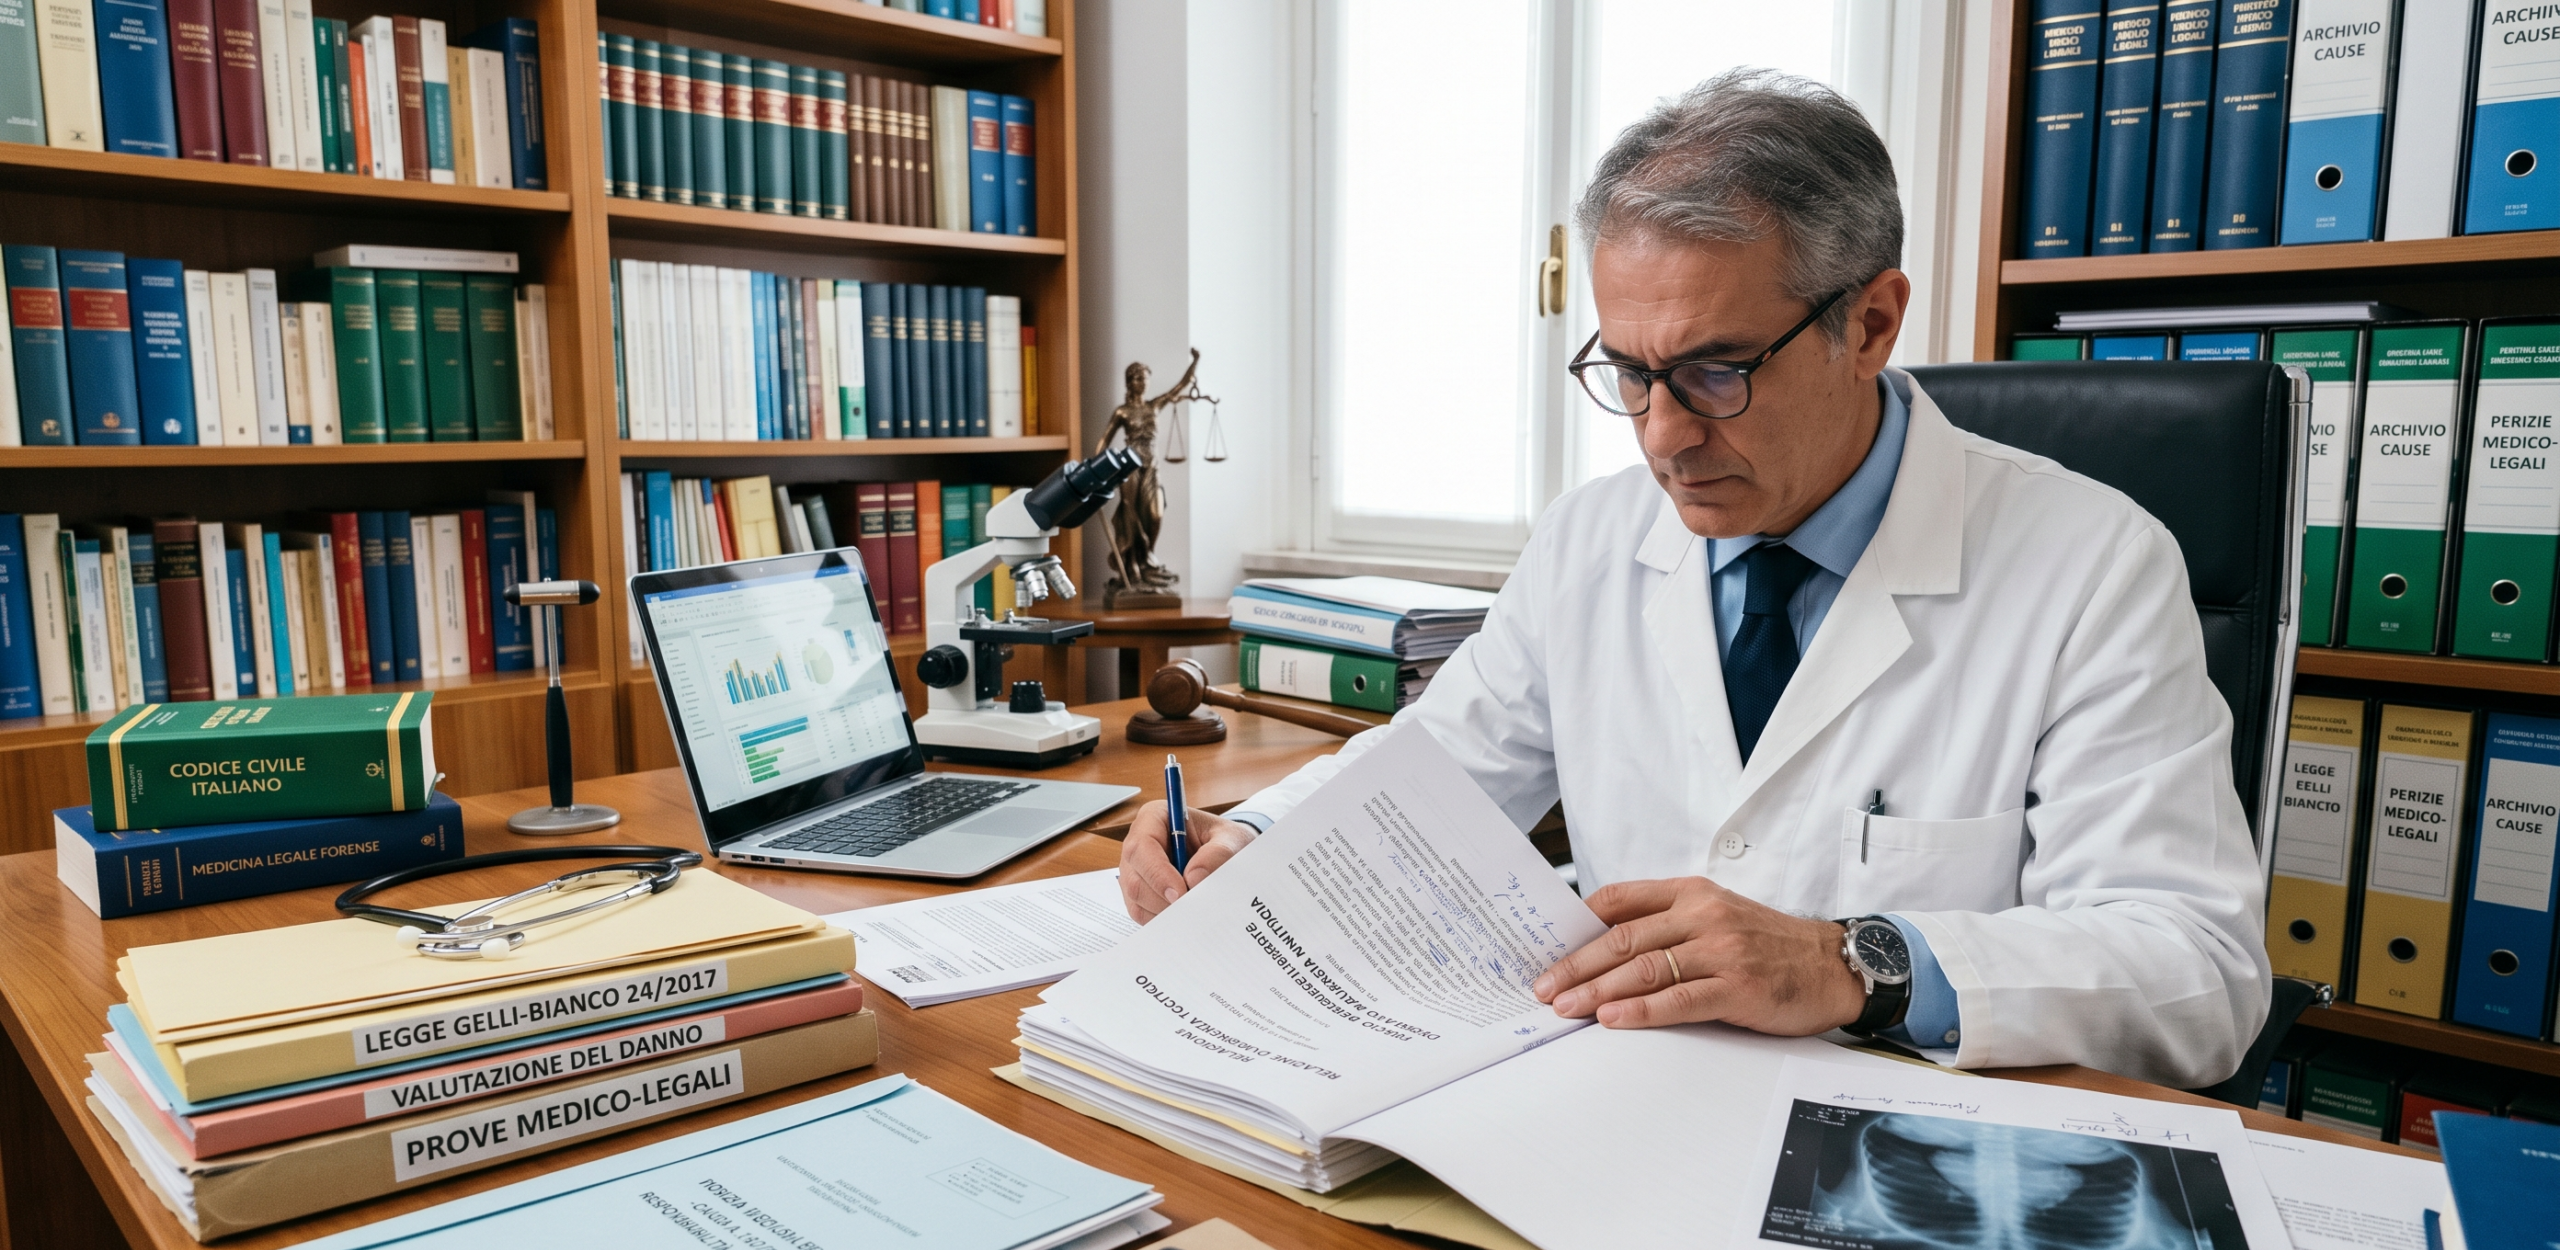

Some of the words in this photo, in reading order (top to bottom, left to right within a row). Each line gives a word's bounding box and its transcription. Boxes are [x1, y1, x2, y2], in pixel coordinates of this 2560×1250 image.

[2303, 21, 2381, 42] ARCHIVIO
[2314, 43, 2366, 61] CAUSE
[2370, 424, 2446, 437] ARCHIVIO
[2491, 415, 2552, 429] PERIZIE
[2380, 443, 2431, 456] CAUSE
[2483, 435, 2559, 449] MEDICO-
[2490, 456, 2546, 470] LEGALI
[169, 760, 242, 778] CODICE
[246, 757, 306, 774] CIVILE
[2294, 762, 2336, 777] LEGGE
[191, 777, 282, 797] ITALIANO
[2296, 780, 2331, 794] EELLI
[2284, 796, 2341, 813] BIANCTO
[2390, 788, 2444, 806] PERIZIE
[2384, 806, 2447, 825] MEDICO-
[2486, 797, 2556, 817] ARCHIVIO
[2388, 825, 2438, 843] LEGALI
[2495, 818, 2543, 835] CAUSE
[192, 856, 264, 876] MEDICINA
[266, 848, 318, 867] LEGALE
[320, 840, 380, 859] FORENSE
[365, 1020, 447, 1054] LEGGE
[453, 987, 620, 1036] GELLI-BIANCO
[626, 969, 717, 1003] 24/2017
[391, 1055, 563, 1108] VALUTAZIONE
[570, 1044, 614, 1070] DEL
[618, 1024, 704, 1059] DANNO
[406, 1119, 508, 1166] PROVE
[516, 1063, 733, 1137] MEDICO-LEGALI
